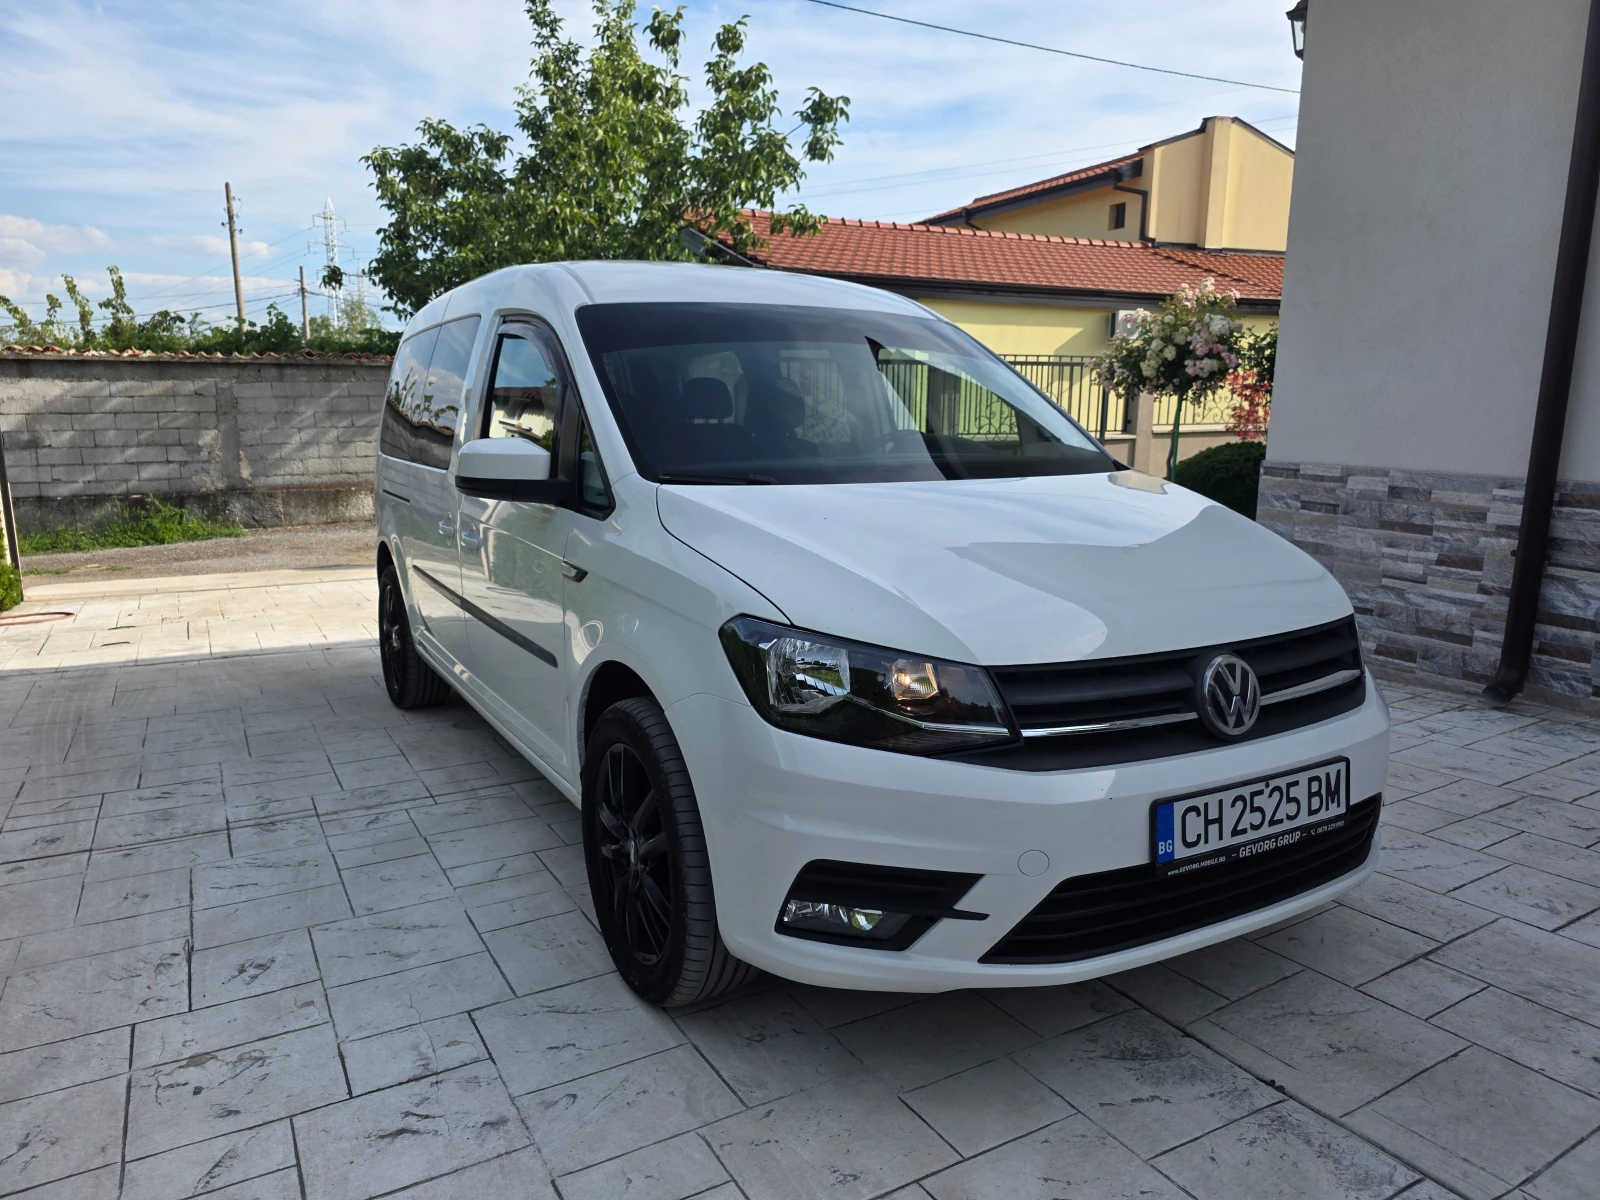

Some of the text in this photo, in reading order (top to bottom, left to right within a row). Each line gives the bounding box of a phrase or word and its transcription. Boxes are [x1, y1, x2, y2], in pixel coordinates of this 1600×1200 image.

[1203, 654, 1261, 736] VW
[1230, 780, 1302, 838] 2525
[1307, 768, 1342, 817] BM
[1158, 839, 1173, 855] BG
[1239, 830, 1301, 858] GEVORG GRUP
